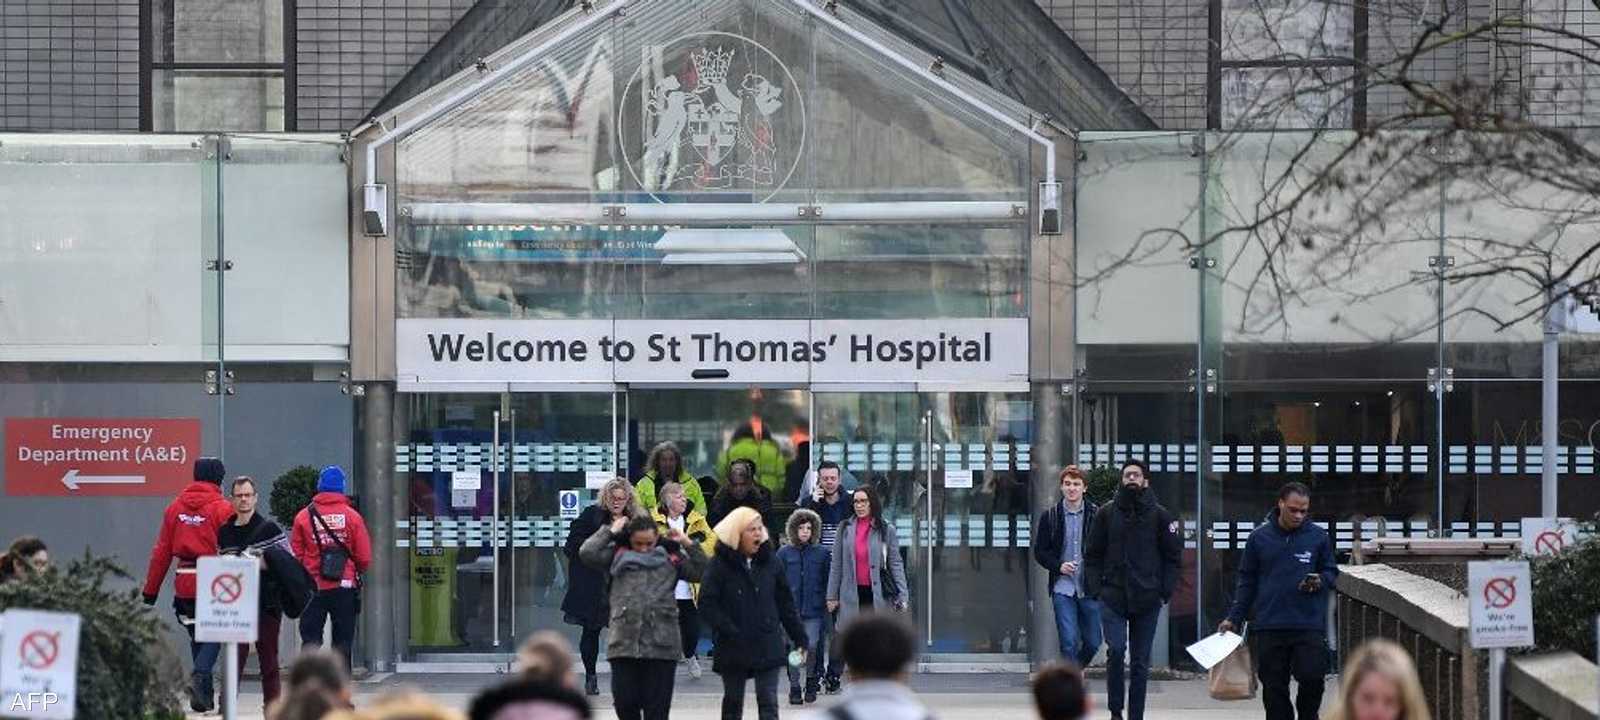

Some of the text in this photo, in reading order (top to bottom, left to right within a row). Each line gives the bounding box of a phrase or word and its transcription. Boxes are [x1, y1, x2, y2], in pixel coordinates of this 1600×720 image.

[427, 332, 588, 363] Welcome
[598, 335, 636, 363] to
[647, 333, 682, 363] St
[850, 332, 992, 370] Hospital
[51, 423, 153, 443] Emergency
[18, 445, 187, 465] Department (A&E)
